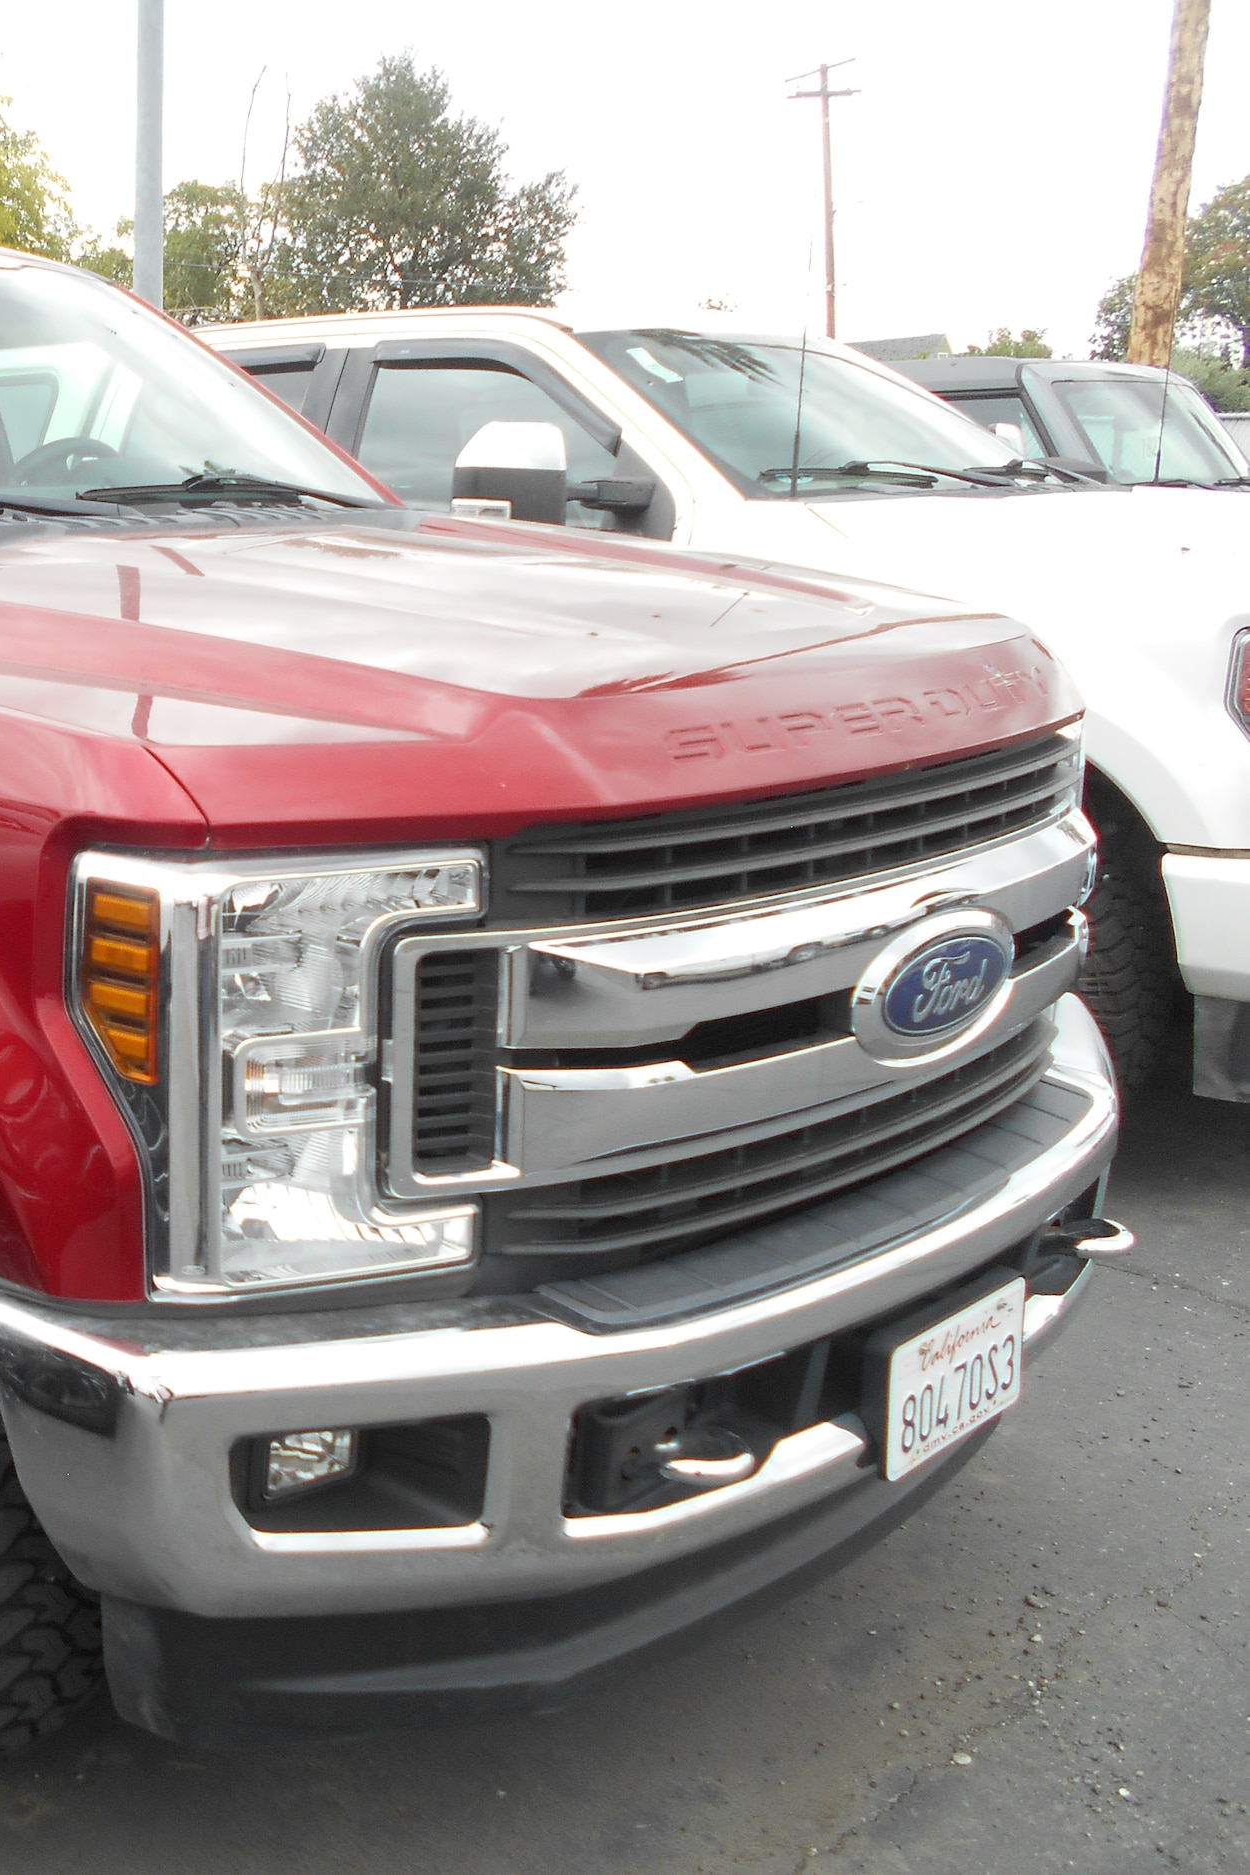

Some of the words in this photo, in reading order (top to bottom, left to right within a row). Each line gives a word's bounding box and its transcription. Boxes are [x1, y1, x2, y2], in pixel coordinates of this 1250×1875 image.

[664, 696, 927, 763] SUPER
[923, 667, 1050, 716] DUTY
[912, 951, 988, 1023] Ford
[920, 1310, 1002, 1371] California
[923, 1406, 991, 1453] dmv.ca.gov
